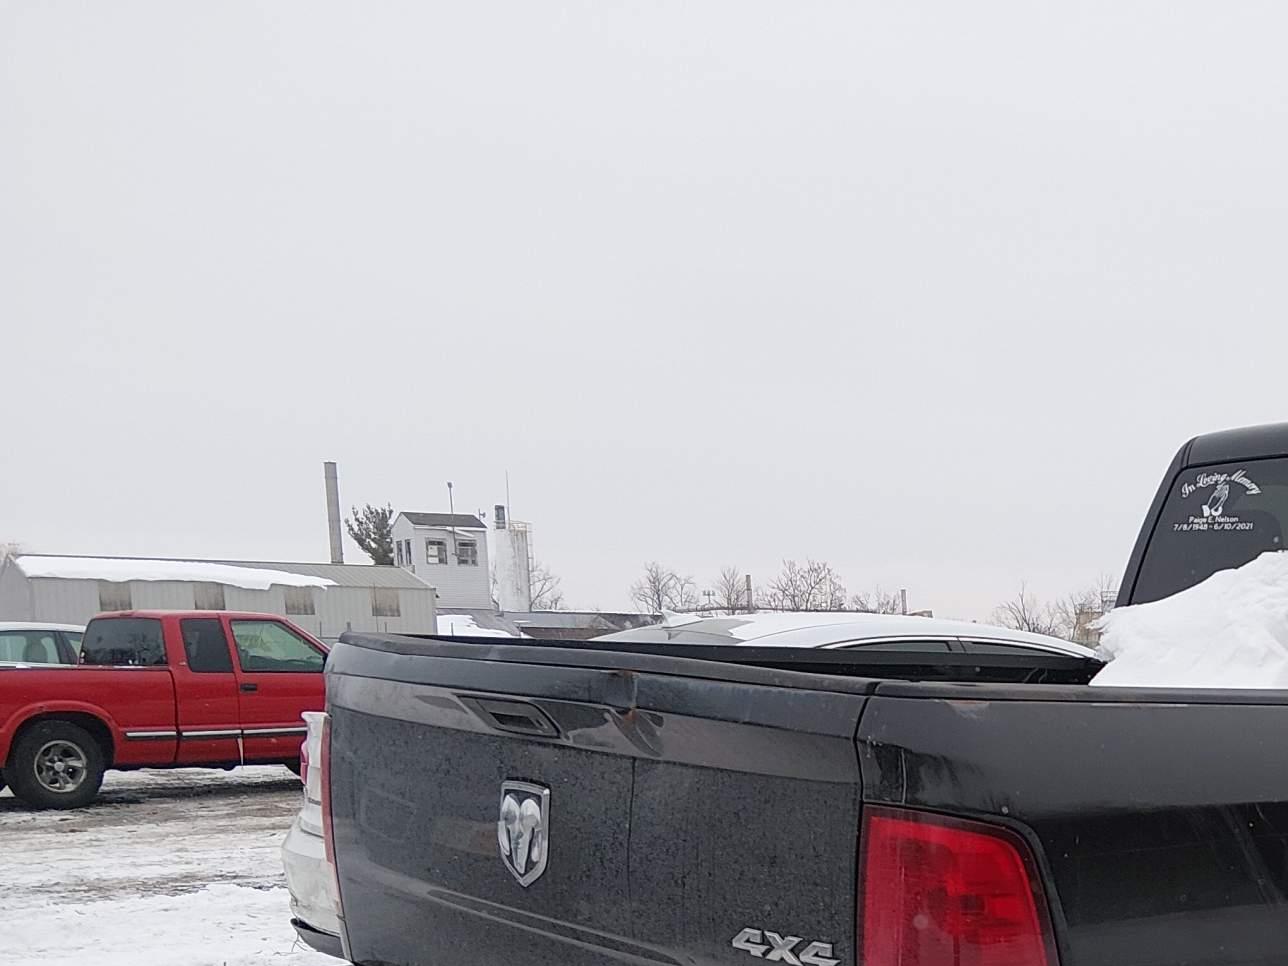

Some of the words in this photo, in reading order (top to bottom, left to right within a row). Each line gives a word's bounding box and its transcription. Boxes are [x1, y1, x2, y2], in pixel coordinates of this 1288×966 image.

[1181, 482, 1196, 498] In
[1196, 472, 1228, 488] Loving
[1227, 469, 1262, 495] Memory
